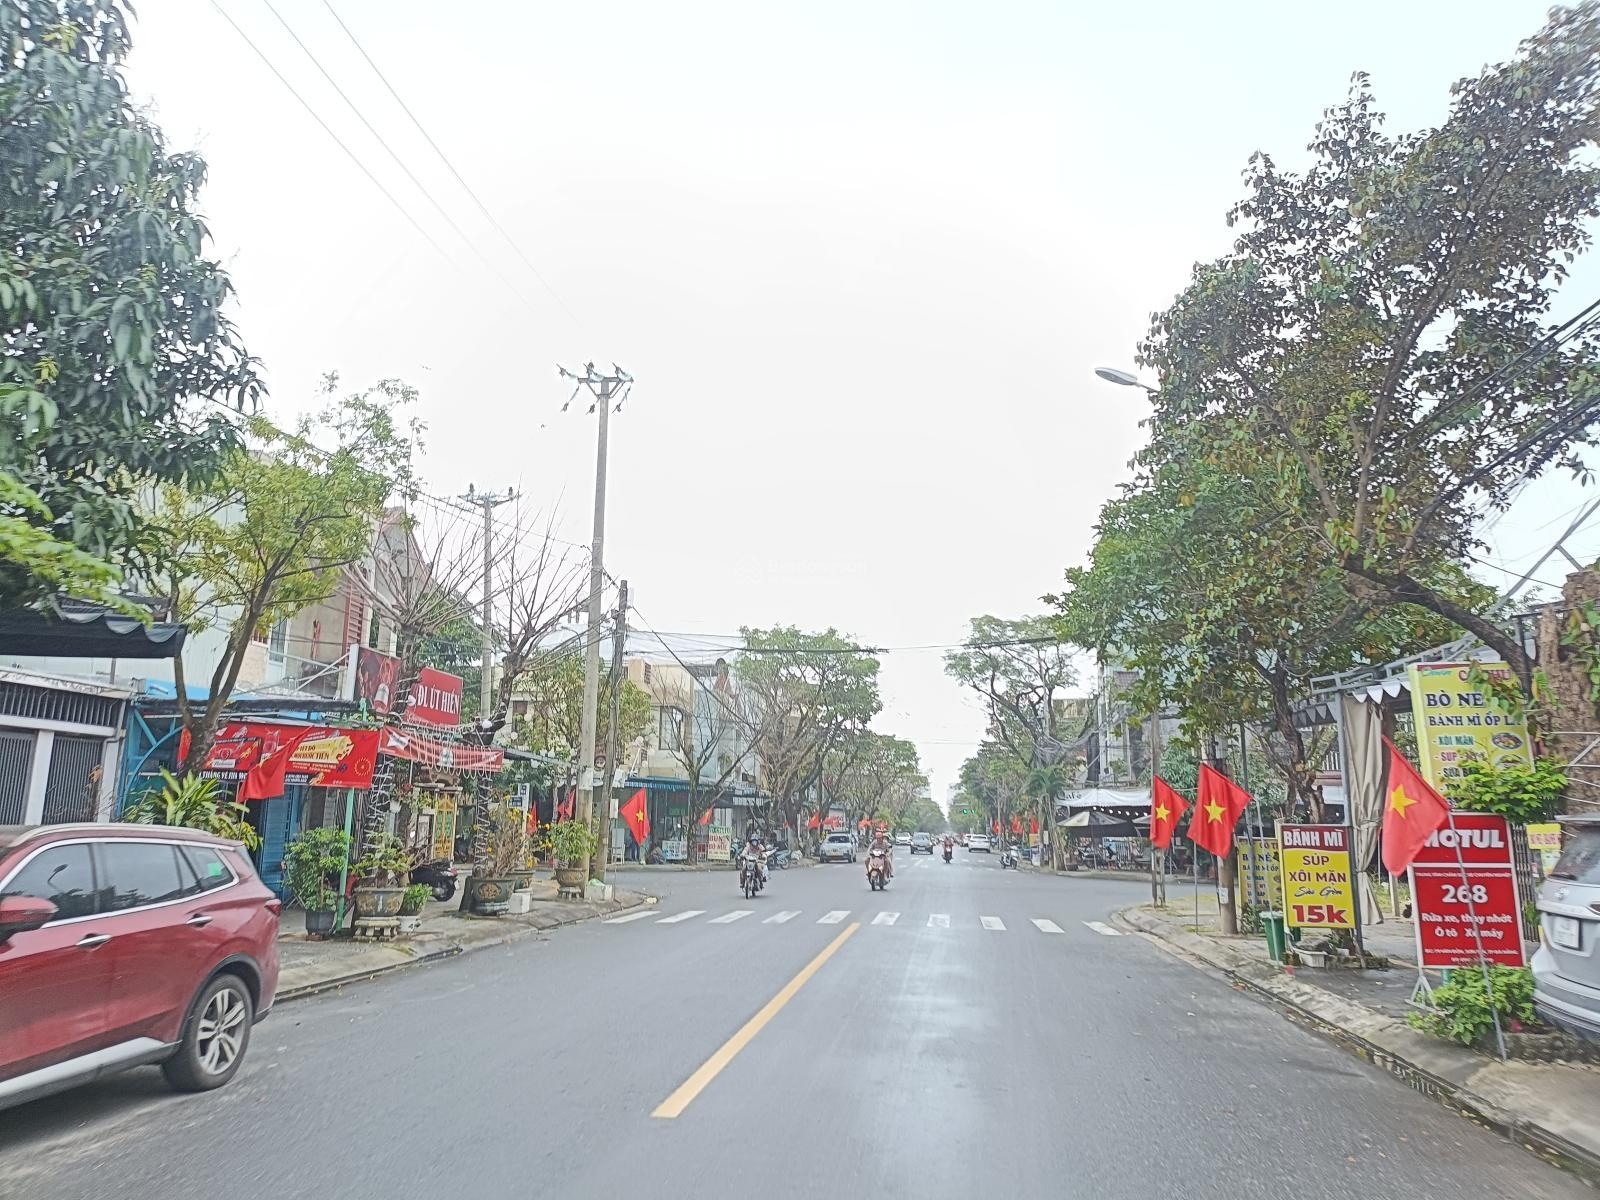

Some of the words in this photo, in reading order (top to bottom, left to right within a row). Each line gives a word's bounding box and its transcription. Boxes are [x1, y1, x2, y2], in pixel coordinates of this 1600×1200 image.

[1425, 690, 1451, 707] BÒ
[1466, 713, 1482, 726] MÌ
[1485, 711, 1501, 726] ỐP
[1283, 828, 1320, 847] BÁNH
[1323, 828, 1344, 847] MÌ
[1289, 869, 1312, 882] XÔI
[1316, 870, 1346, 885] MẶN
[1441, 884, 1488, 904] 268
[1292, 904, 1349, 923] 15k
